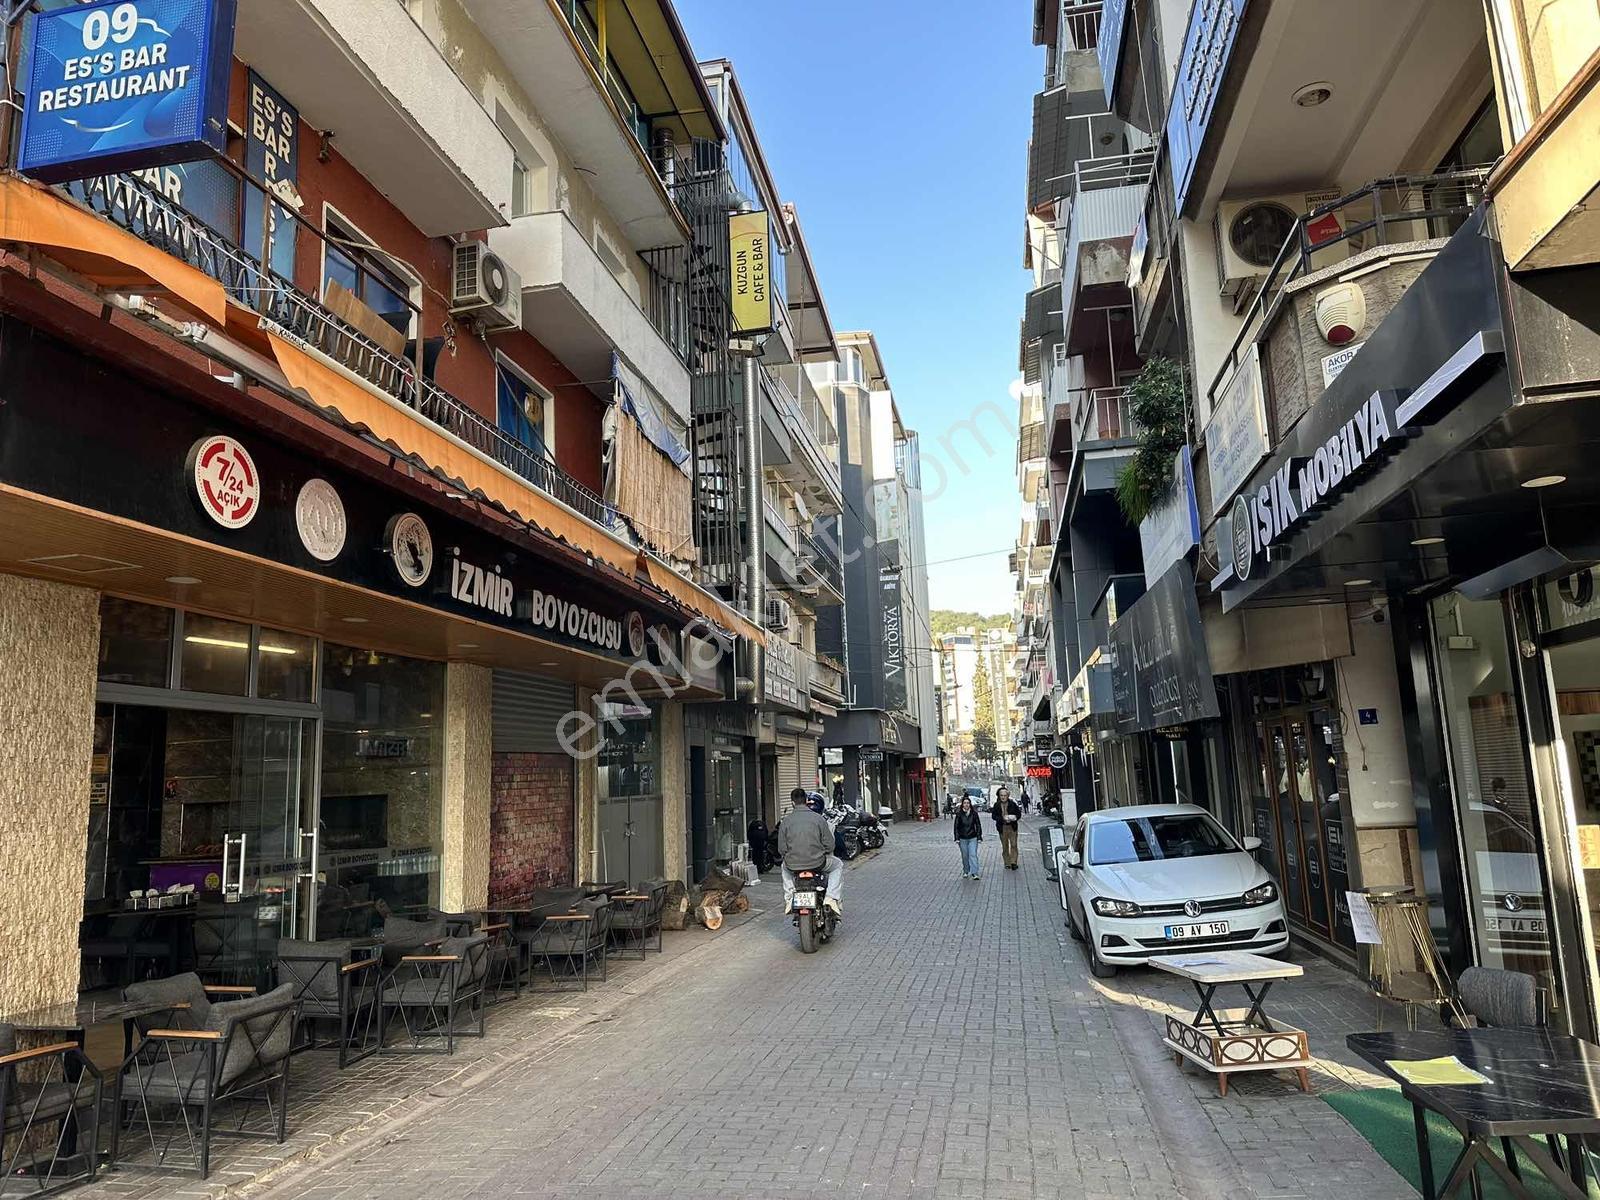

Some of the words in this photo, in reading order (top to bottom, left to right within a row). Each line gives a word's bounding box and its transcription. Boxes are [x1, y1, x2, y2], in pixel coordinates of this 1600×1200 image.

[82, 3, 138, 51] 09
[63, 53, 114, 81] ES'S
[119, 43, 167, 72] BAR
[38, 65, 191, 113] RESTAURANT
[252, 83, 294, 138] ES'S
[253, 112, 291, 164] BAR
[752, 238, 763, 261] BAR
[736, 250, 748, 295] KUZGUN
[753, 273, 765, 302] CAFE
[1298, 389, 1391, 514] MOBİLYA
[216, 456, 244, 495] 7/24
[217, 489, 241, 508] AÇIK
[451, 546, 514, 617] İZMİR
[531, 589, 622, 651] BOYOZCUSU
[1172, 926, 1185, 938] 09
[1191, 925, 1201, 936] AV
[1209, 923, 1227, 934] 150
